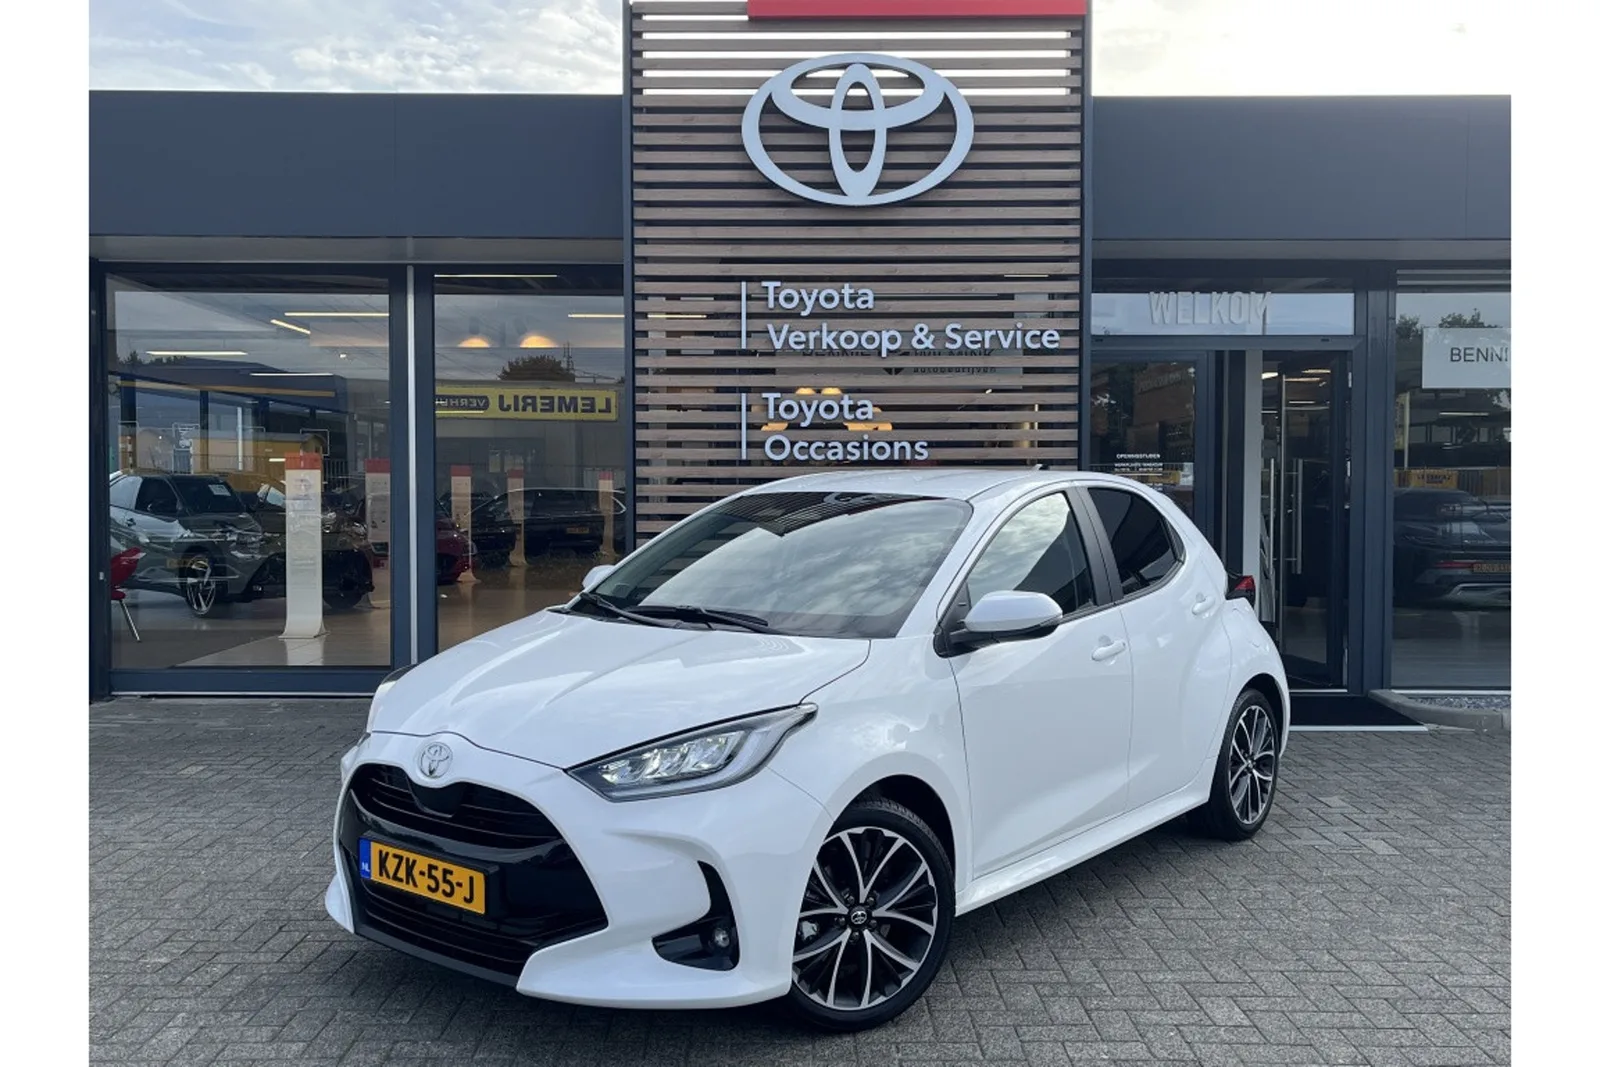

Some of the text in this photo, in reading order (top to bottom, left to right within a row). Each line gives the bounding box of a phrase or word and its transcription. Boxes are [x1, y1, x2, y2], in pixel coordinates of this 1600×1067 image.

[761, 281, 875, 316] Toyota
[1149, 291, 1272, 325] WELKOM
[767, 322, 1060, 357] Verkoop & Service
[761, 393, 874, 427] Toyota
[764, 434, 929, 460] Occasions
[378, 850, 475, 904] KZK-55-J
